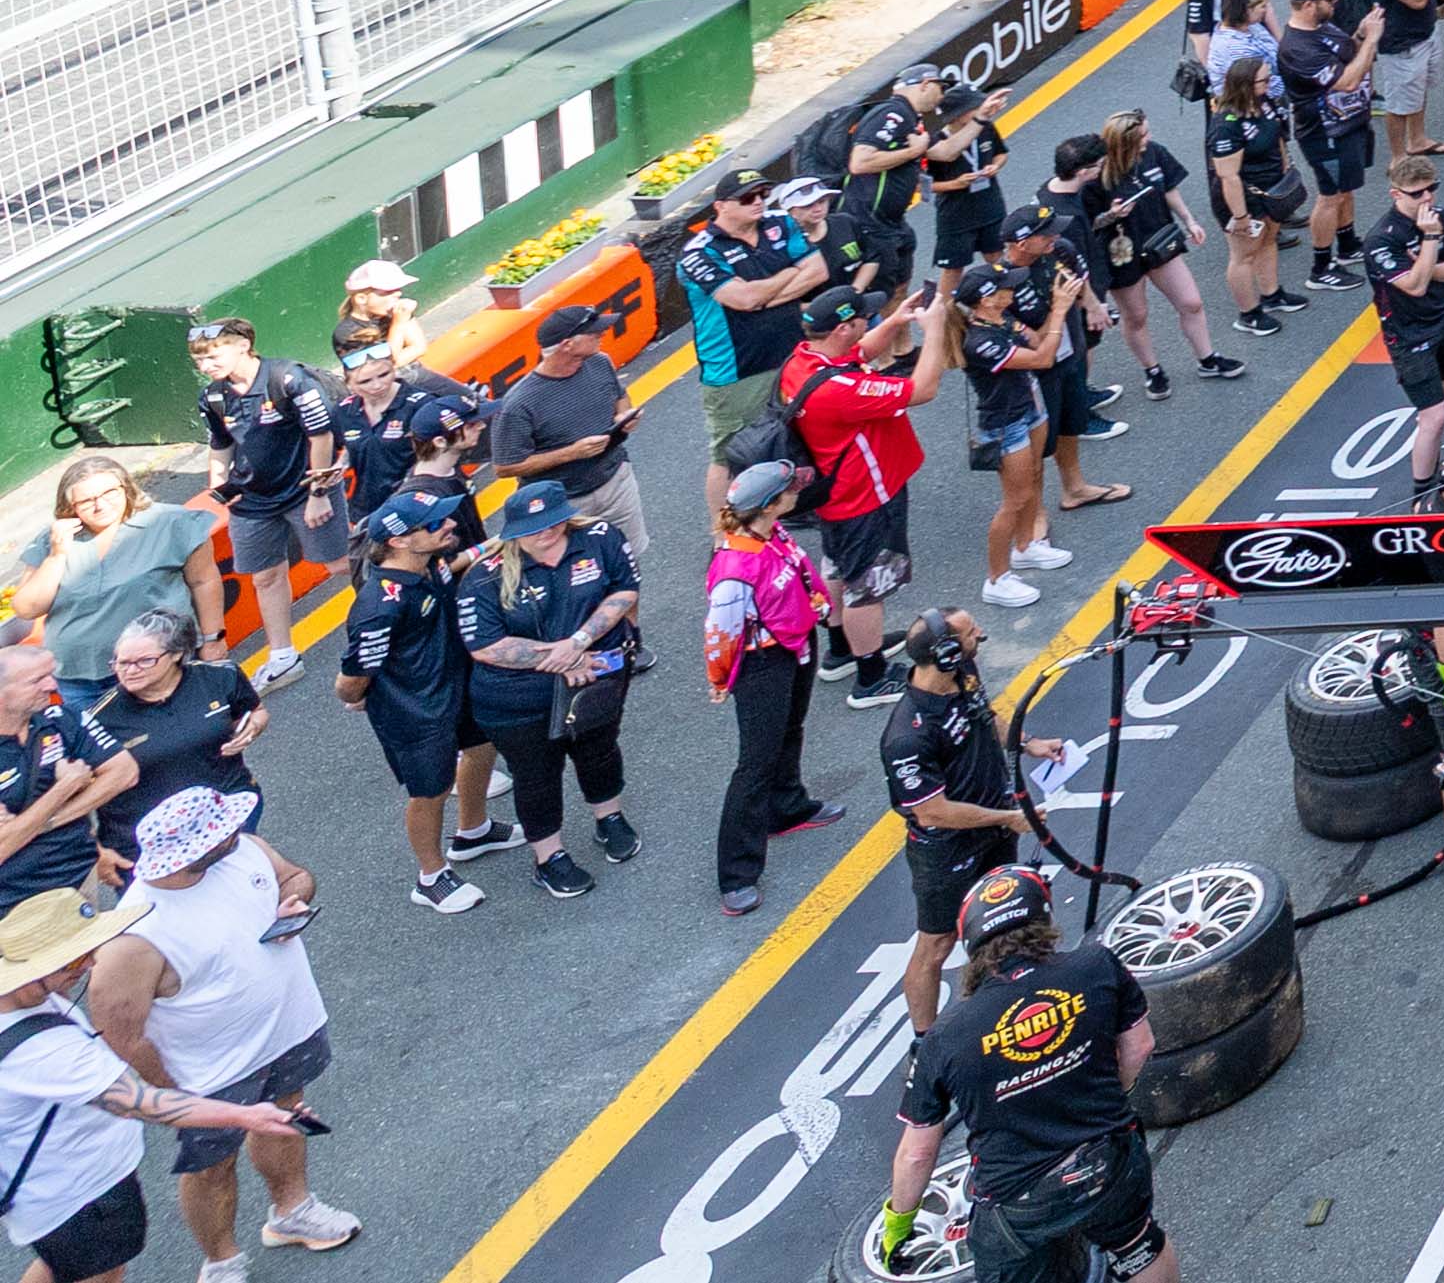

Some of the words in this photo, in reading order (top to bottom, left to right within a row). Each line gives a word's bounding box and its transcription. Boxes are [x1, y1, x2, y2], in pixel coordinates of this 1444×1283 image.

[1232, 535, 1341, 583] Gates
[981, 907, 1029, 932] STRETCH
[980, 992, 1087, 1056] PENRITE
[994, 1056, 1065, 1093] RACING
